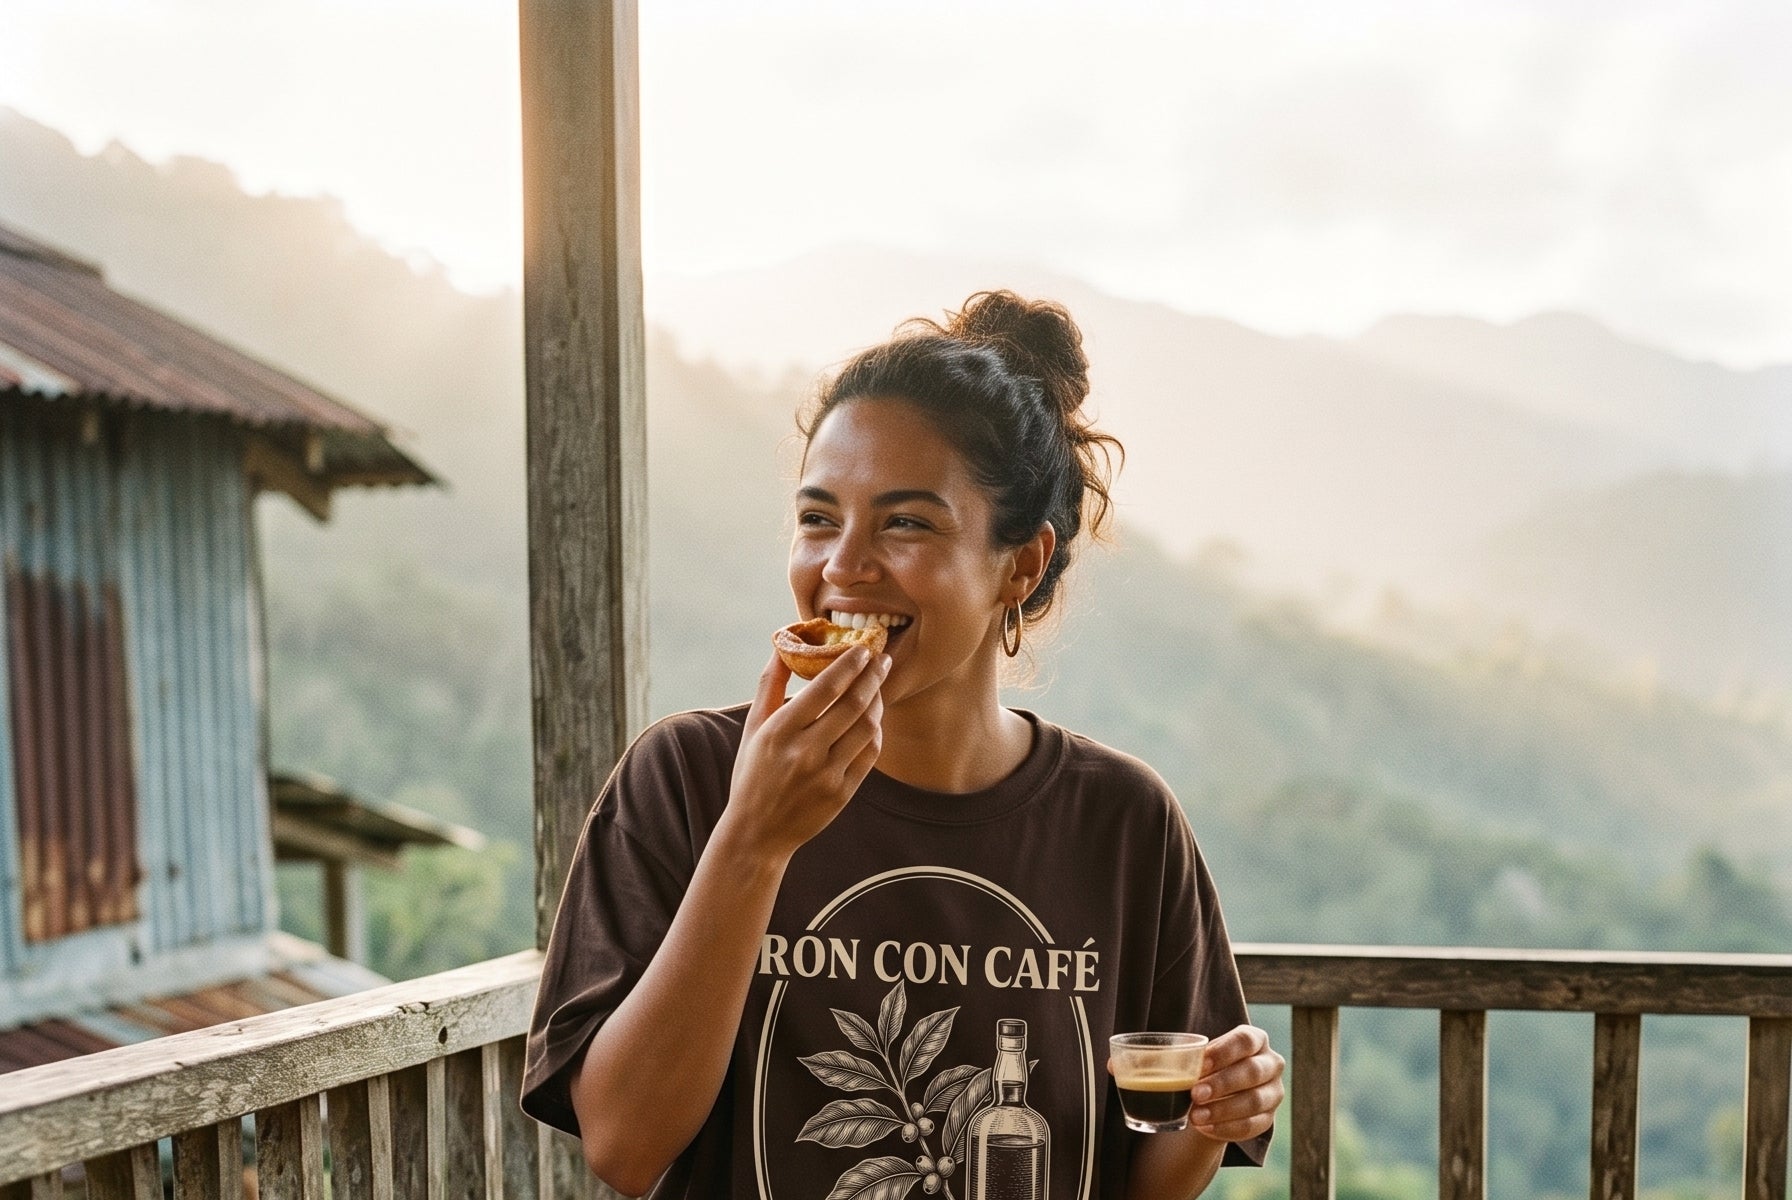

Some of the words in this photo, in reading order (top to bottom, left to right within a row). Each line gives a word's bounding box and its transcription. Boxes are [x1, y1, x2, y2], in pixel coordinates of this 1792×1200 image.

[758, 933, 860, 980] RON
[873, 940, 971, 986] CON
[984, 937, 1100, 992] CAFÉ
